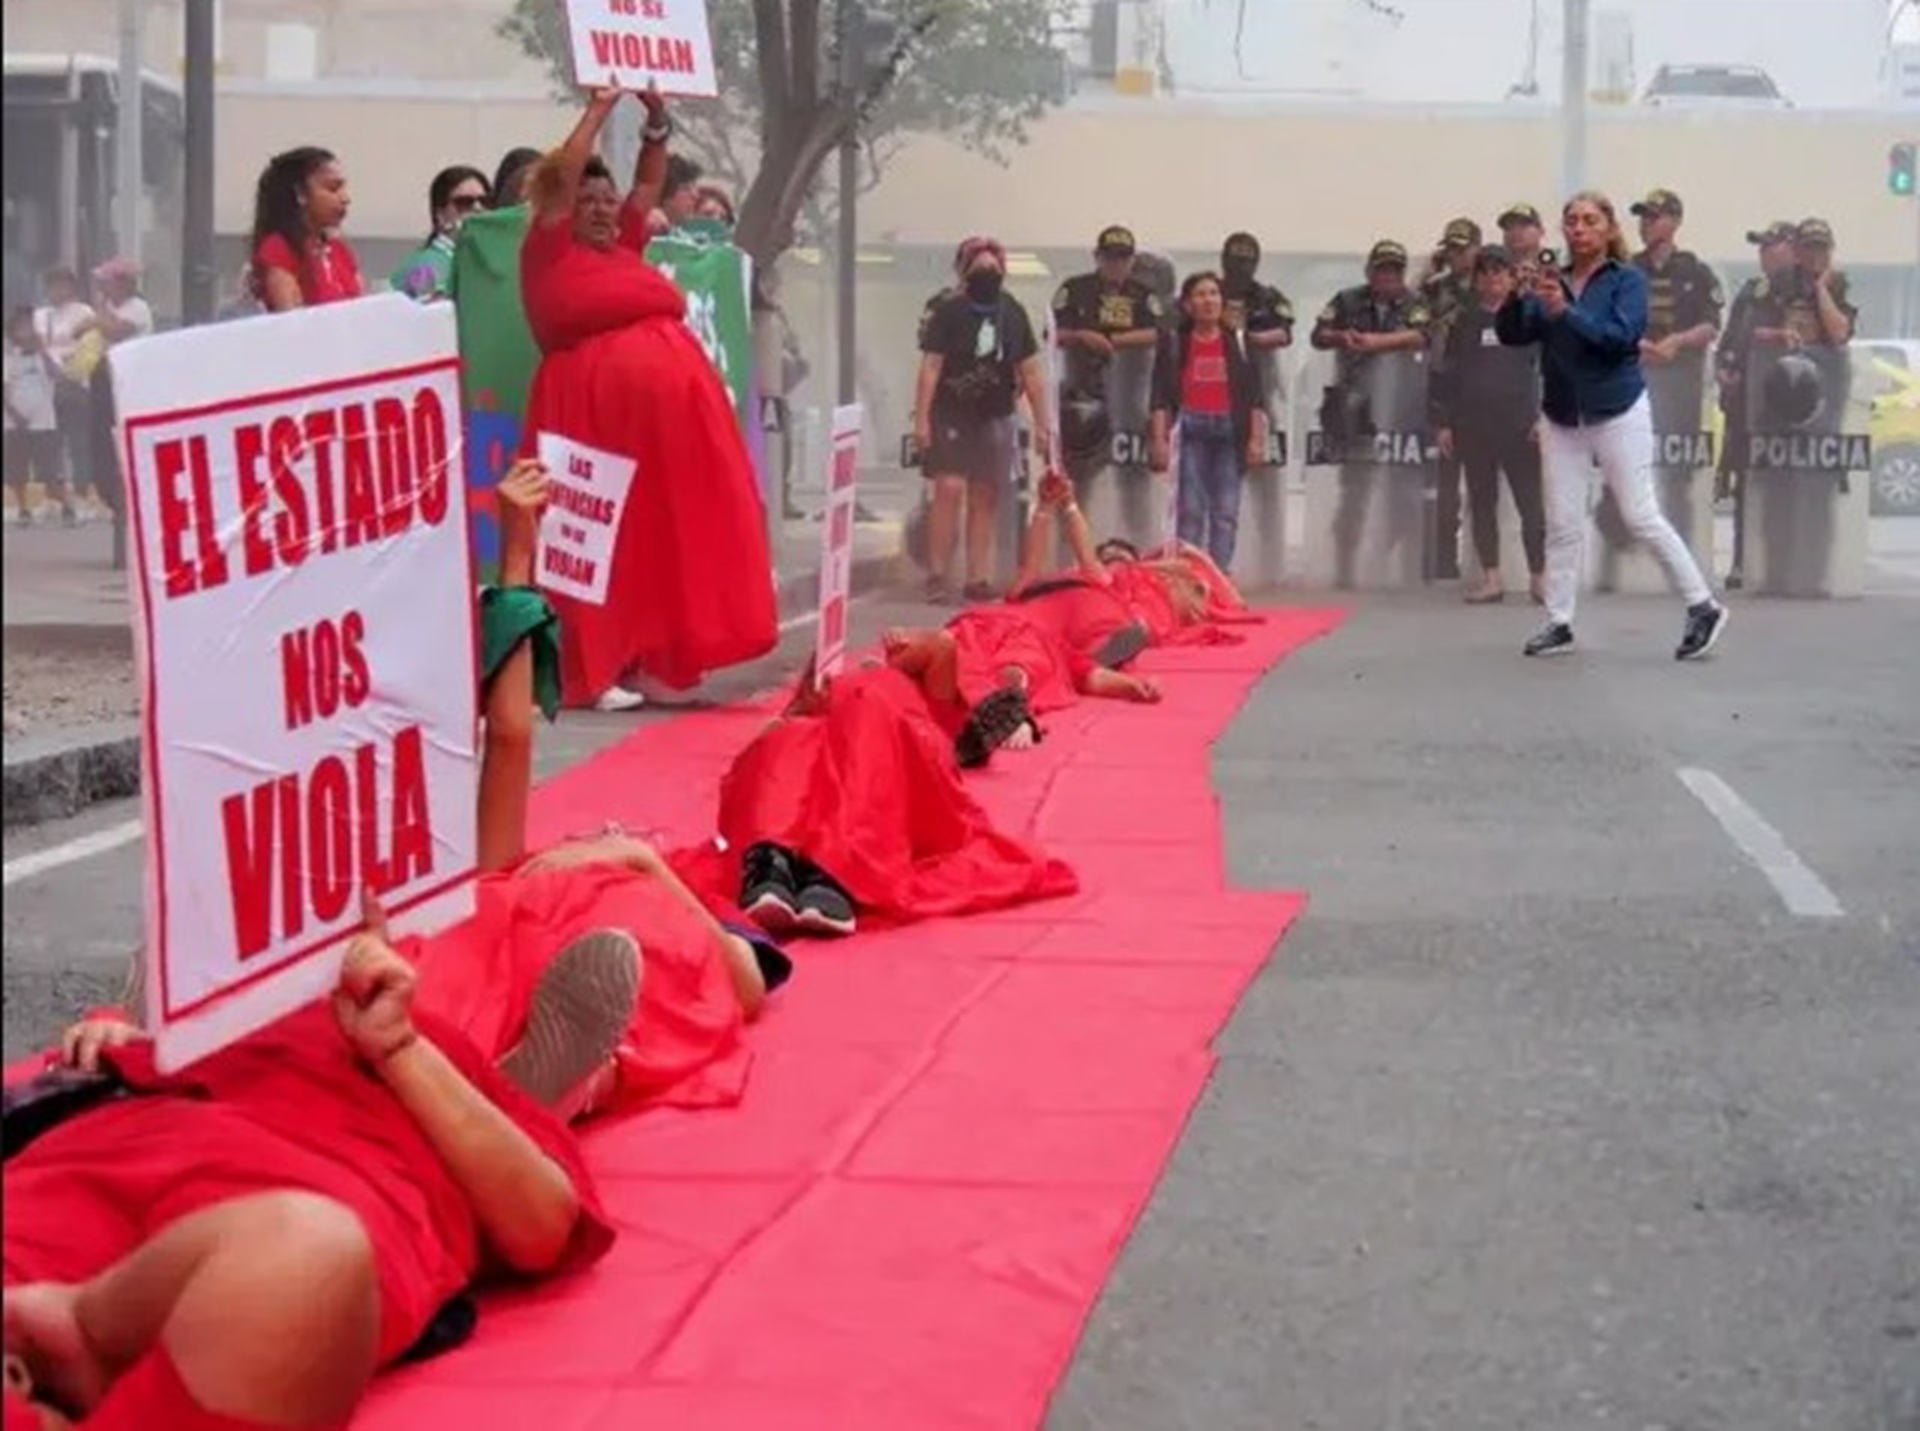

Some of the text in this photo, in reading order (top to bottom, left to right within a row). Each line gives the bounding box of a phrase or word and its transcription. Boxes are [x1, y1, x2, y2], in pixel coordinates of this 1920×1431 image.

[590, 30, 694, 73] VIOLAN
[154, 435, 229, 598] EL
[235, 387, 449, 577] ESTADO
[1750, 435, 1866, 467] POLICIA
[281, 610, 370, 730] NOS
[221, 725, 433, 962] VIOLA
